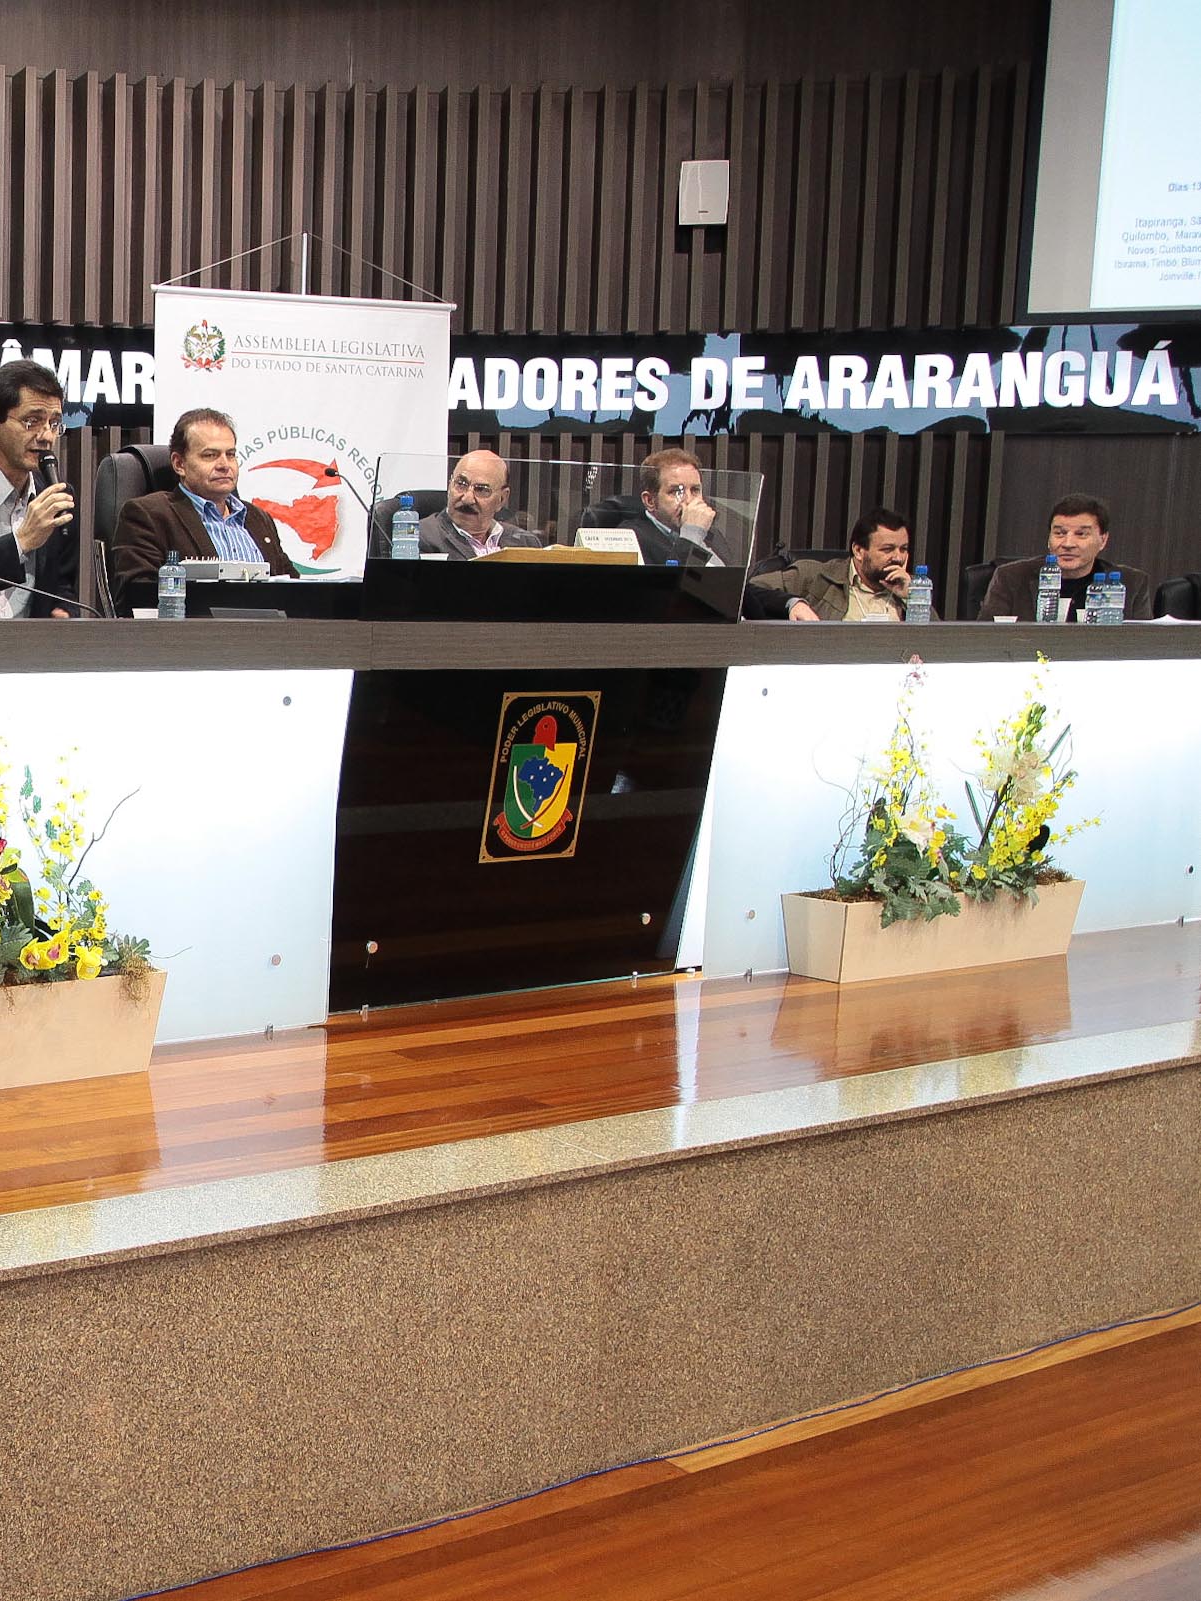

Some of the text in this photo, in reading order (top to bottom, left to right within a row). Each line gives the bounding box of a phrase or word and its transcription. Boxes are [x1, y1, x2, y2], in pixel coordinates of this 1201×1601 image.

[233, 335, 426, 358] ASSEMBLEIA LEGISLATIVA
[232, 357, 425, 379] DO ESTADO DE SANTA CATARINA
[448, 357, 671, 411] ADORES
[690, 356, 766, 410] DE
[783, 340, 1179, 410] ARARANGUÁ
[267, 425, 347, 451] PÚBLICAS
[500, 701, 587, 763] PODER LEGISLATIVO MUNICIPAL
